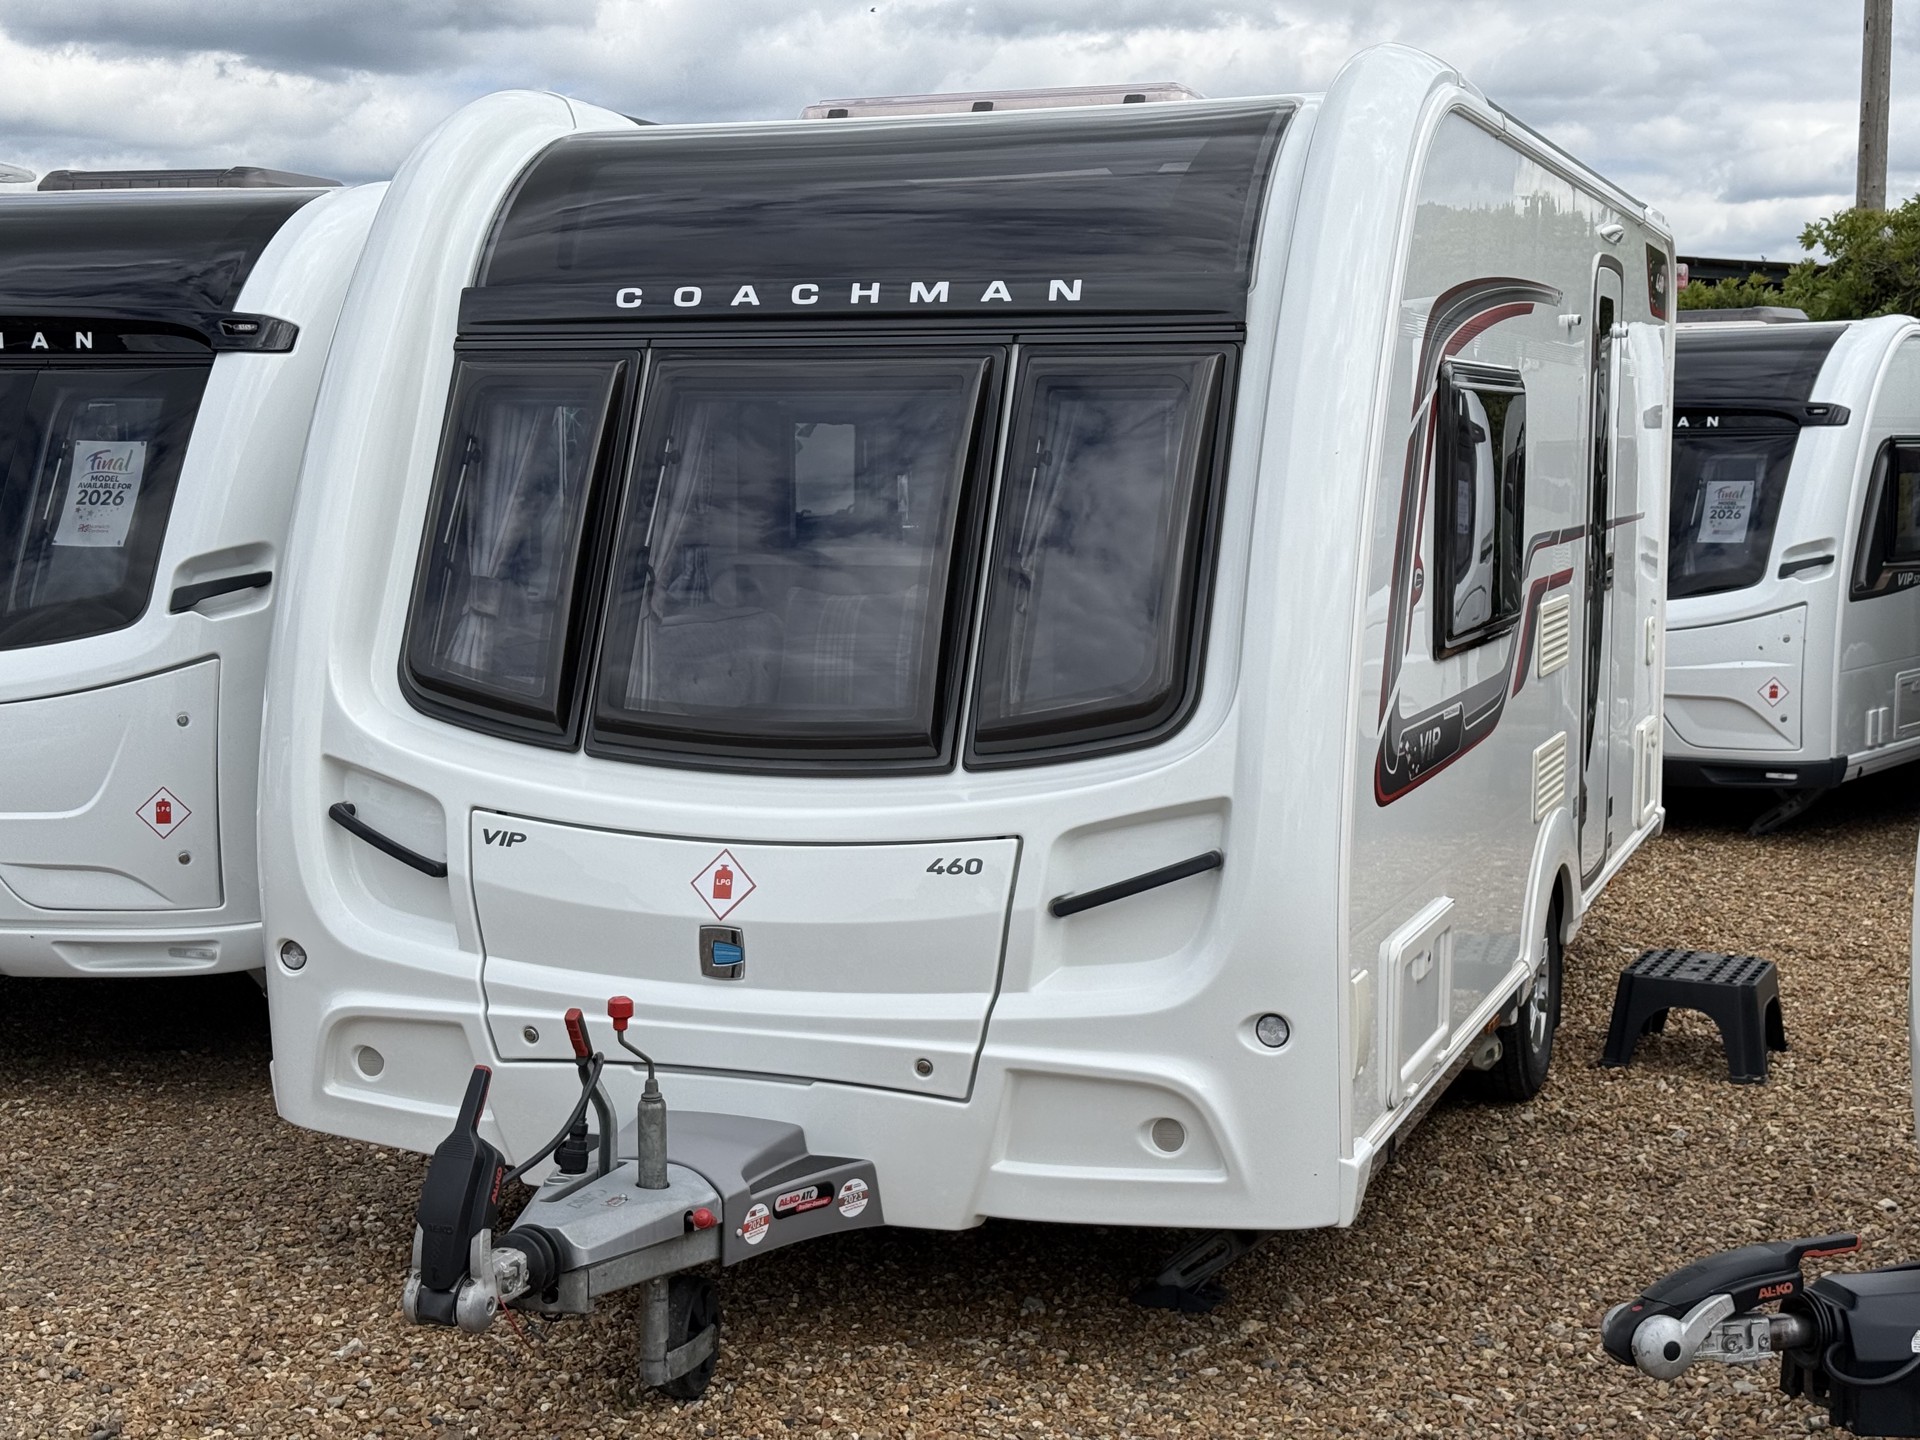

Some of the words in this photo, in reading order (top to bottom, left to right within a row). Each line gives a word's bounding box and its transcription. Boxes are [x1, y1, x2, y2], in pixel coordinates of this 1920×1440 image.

[616, 279, 1083, 309] COACHMAN
[0, 331, 93, 349] AN
[85, 449, 133, 471] Final
[91, 475, 119, 483] MODEL
[76, 489, 125, 506] 2026
[1710, 510, 1742, 520] 2026
[1897, 572, 1914, 586] VIP
[1419, 726, 1441, 763] VIP
[483, 828, 527, 847] VIP
[926, 857, 984, 875] 460
[716, 878, 731, 886] LPG
[800, 1189, 815, 1201] ATC
[843, 1192, 864, 1205] 2023
[748, 1218, 765, 1231] 2024
[1758, 1282, 1793, 1299] AL-KO
